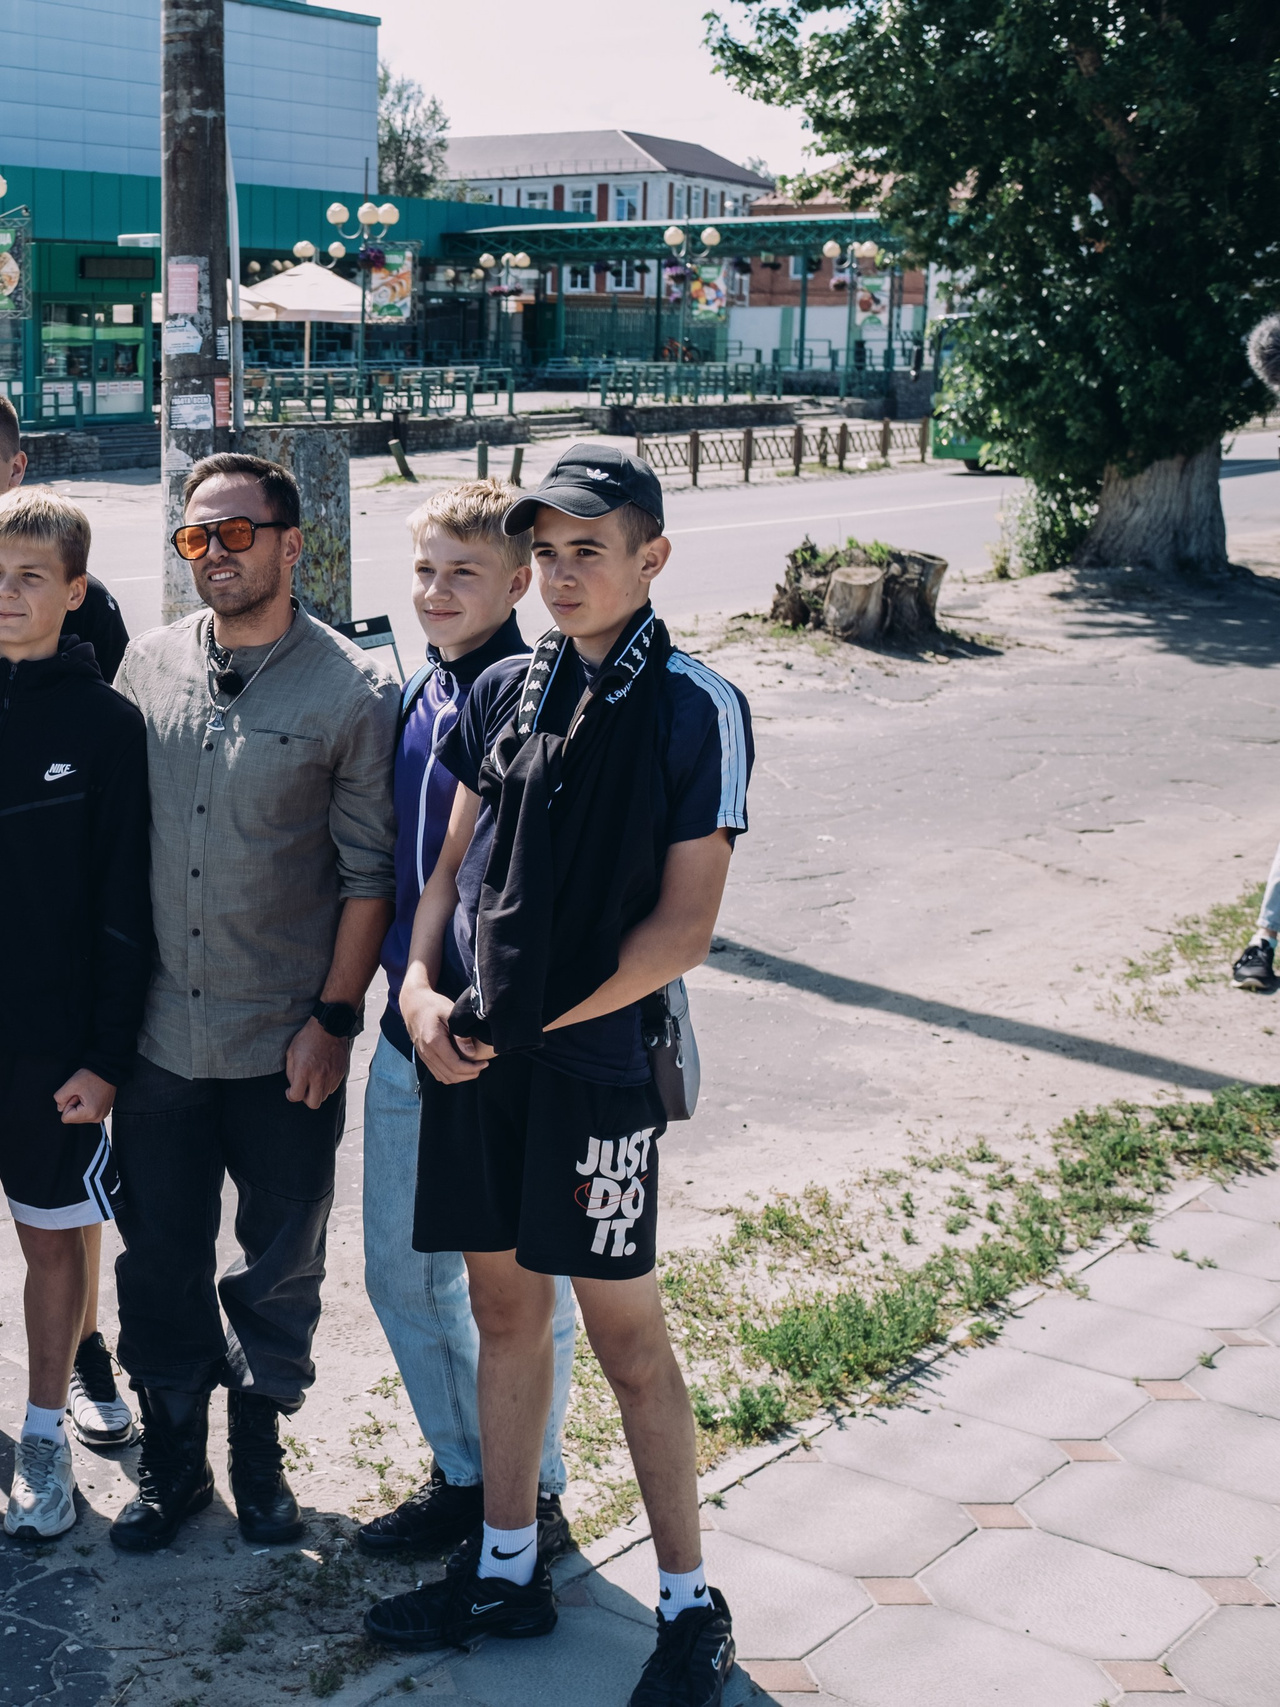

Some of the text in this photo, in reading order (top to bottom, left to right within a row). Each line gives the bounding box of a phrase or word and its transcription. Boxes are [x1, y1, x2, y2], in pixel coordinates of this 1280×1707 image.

[49, 763, 72, 774] NIKE
[575, 1126, 657, 1181] JUST
[586, 1176, 645, 1219] DO
[590, 1218, 637, 1257] IT.
